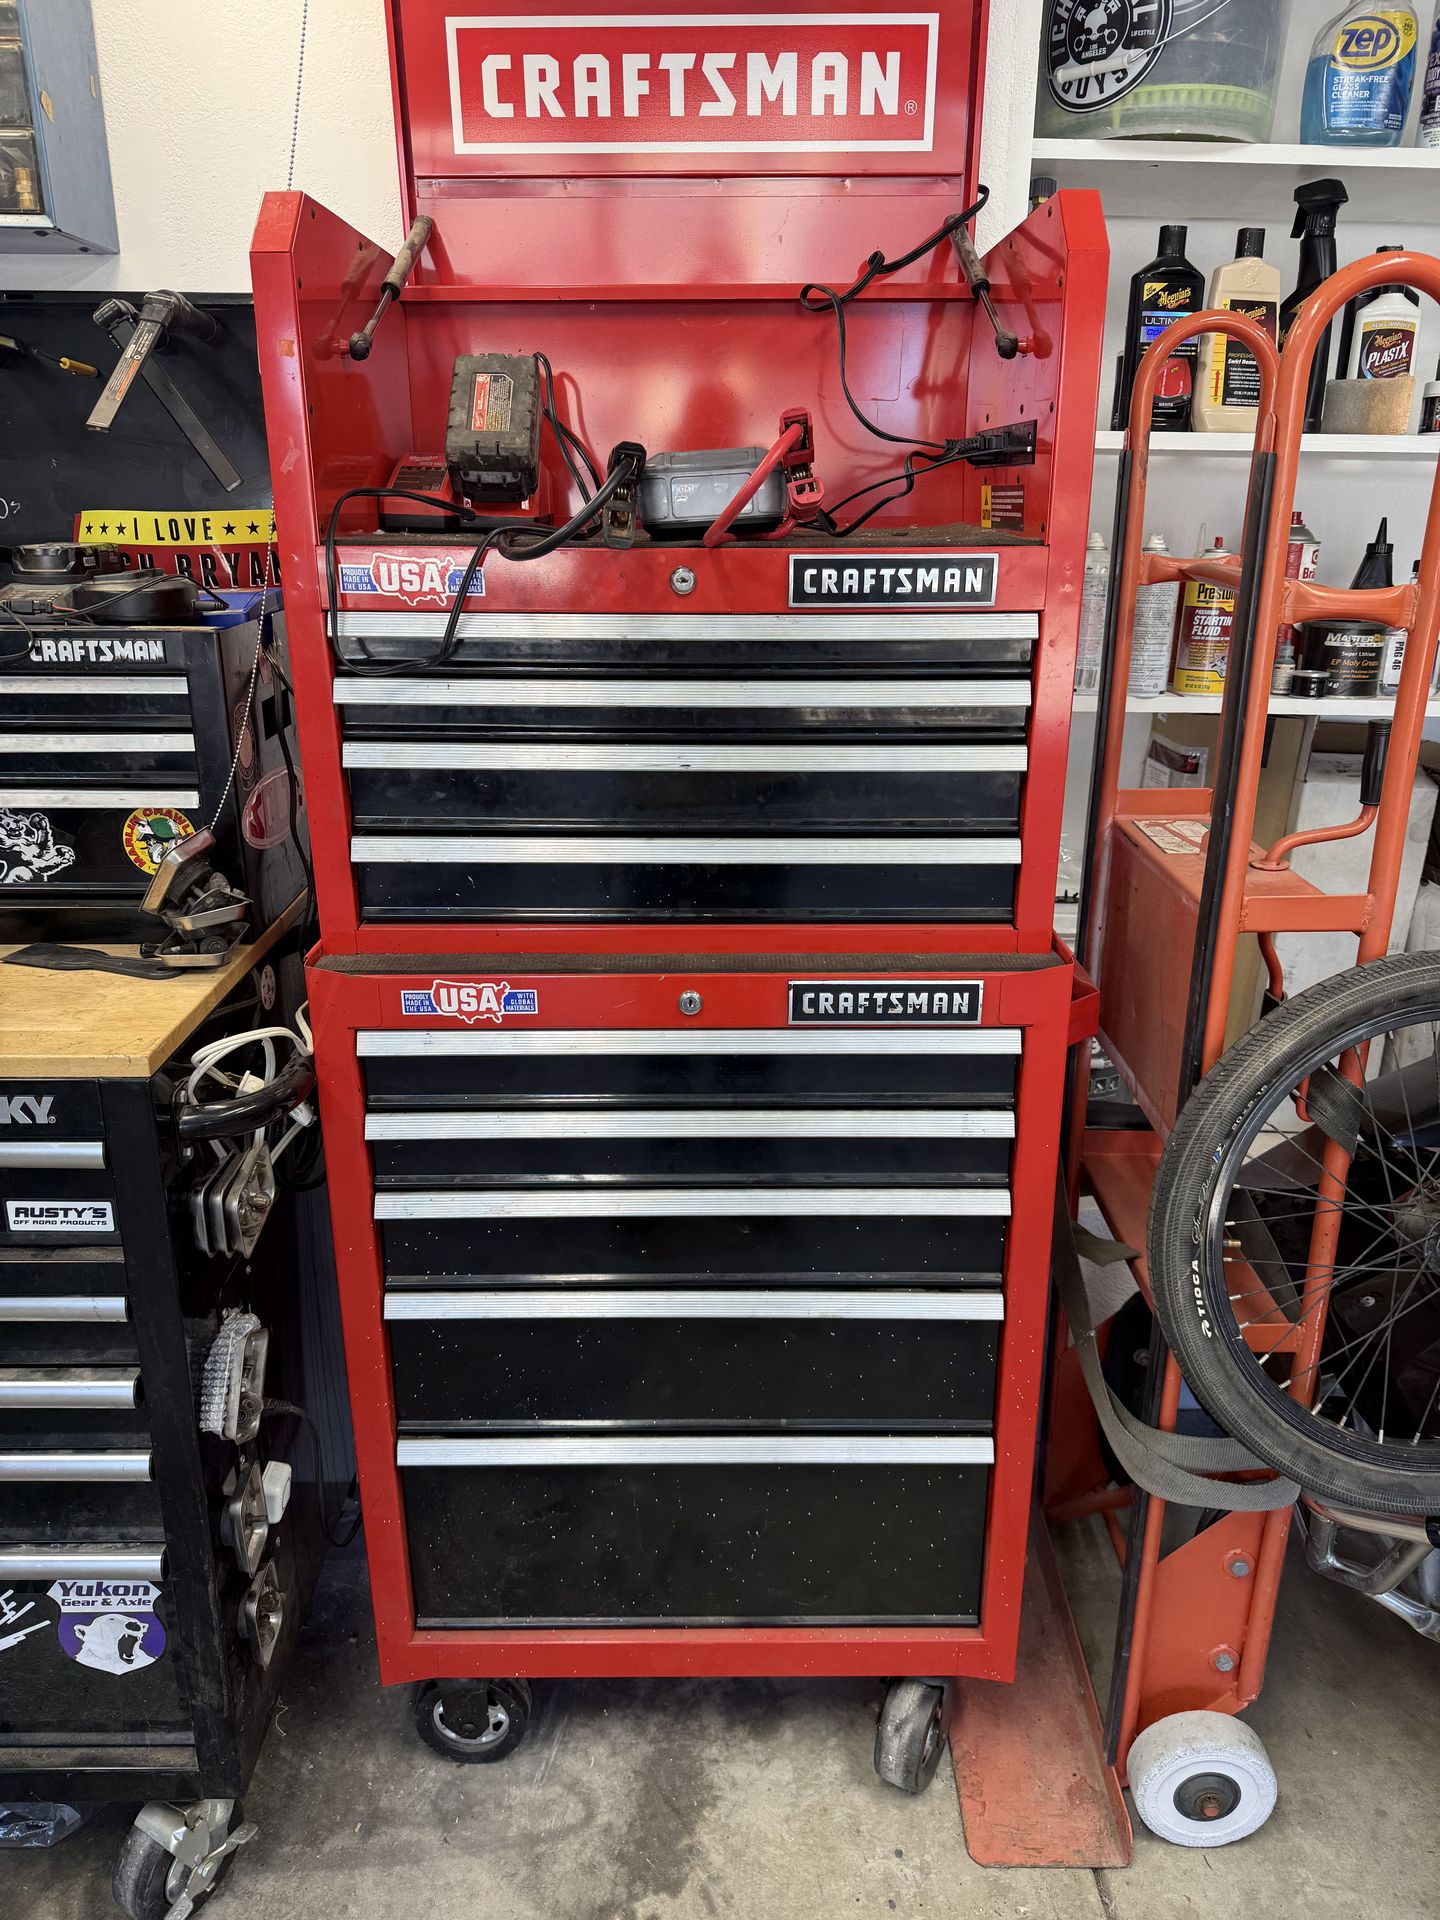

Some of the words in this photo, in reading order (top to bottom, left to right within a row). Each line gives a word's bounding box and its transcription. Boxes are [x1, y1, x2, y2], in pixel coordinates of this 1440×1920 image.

[1081, 48, 1107, 59] ANGELES
[480, 51, 900, 118] CRAFTSMAN
[1332, 83, 1359, 91] GLASS
[1333, 75, 1390, 84] STREAK-FREE
[1331, 90, 1371, 99] CLEANER
[1145, 317, 1179, 325] ULTIM
[134, 518, 140, 541] I
[154, 517, 213, 542] LOVE
[343, 568, 369, 576] PROUDLY
[379, 562, 444, 592] USA
[802, 567, 984, 595] CRAFTSMAN
[1197, 583, 1235, 600] Presto
[1193, 615, 1232, 626] STARTIN
[1192, 625, 1221, 636] FLUID
[29, 640, 165, 662] CRAFTSMAN
[1393, 641, 1405, 658] PAG
[1343, 660, 1360, 668] Moly
[143, 808, 196, 837] CRAWL
[125, 815, 147, 868] MARLIN
[439, 987, 500, 1012] USA
[801, 991, 970, 1015] CRAFTSMAN
[14, 1207, 107, 1219] RUSTY'S
[1191, 1260, 1206, 1317] TIOGA
[57, 1581, 151, 1597] Yukon
[61, 1598, 98, 1607] Gear
[101, 1598, 113, 1606] &
[116, 1597, 152, 1607] Axle
